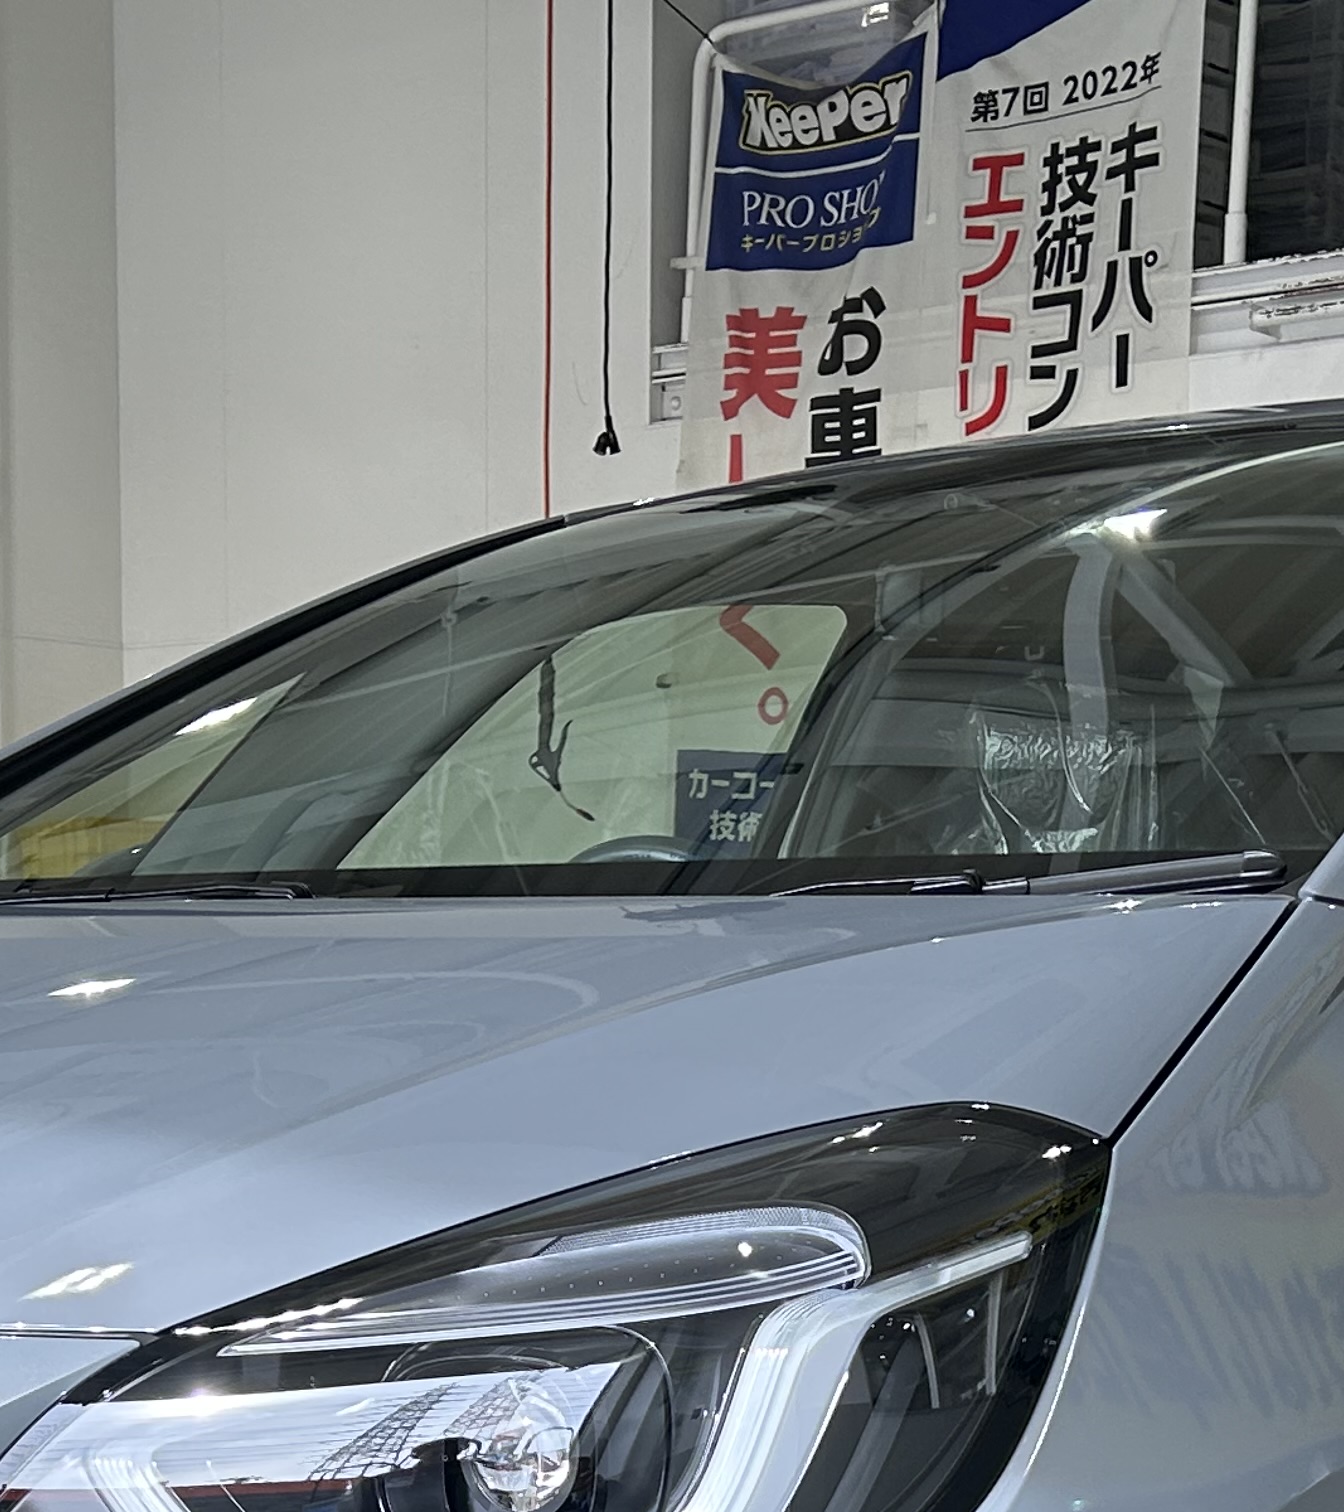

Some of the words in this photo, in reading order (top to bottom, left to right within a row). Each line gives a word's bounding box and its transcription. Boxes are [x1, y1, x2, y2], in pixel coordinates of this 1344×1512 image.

[742, 74, 911, 151] KeePer
[970, 82, 1050, 123] 第7回
[1062, 51, 1162, 106] 2022年
[742, 190, 816, 229] PRO
[820, 170, 885, 228] SHO
[1028, 135, 1102, 432] 技術コン
[1090, 121, 1160, 388] キーパー
[804, 285, 887, 468] お車
[959, 152, 1025, 436] エントリ
